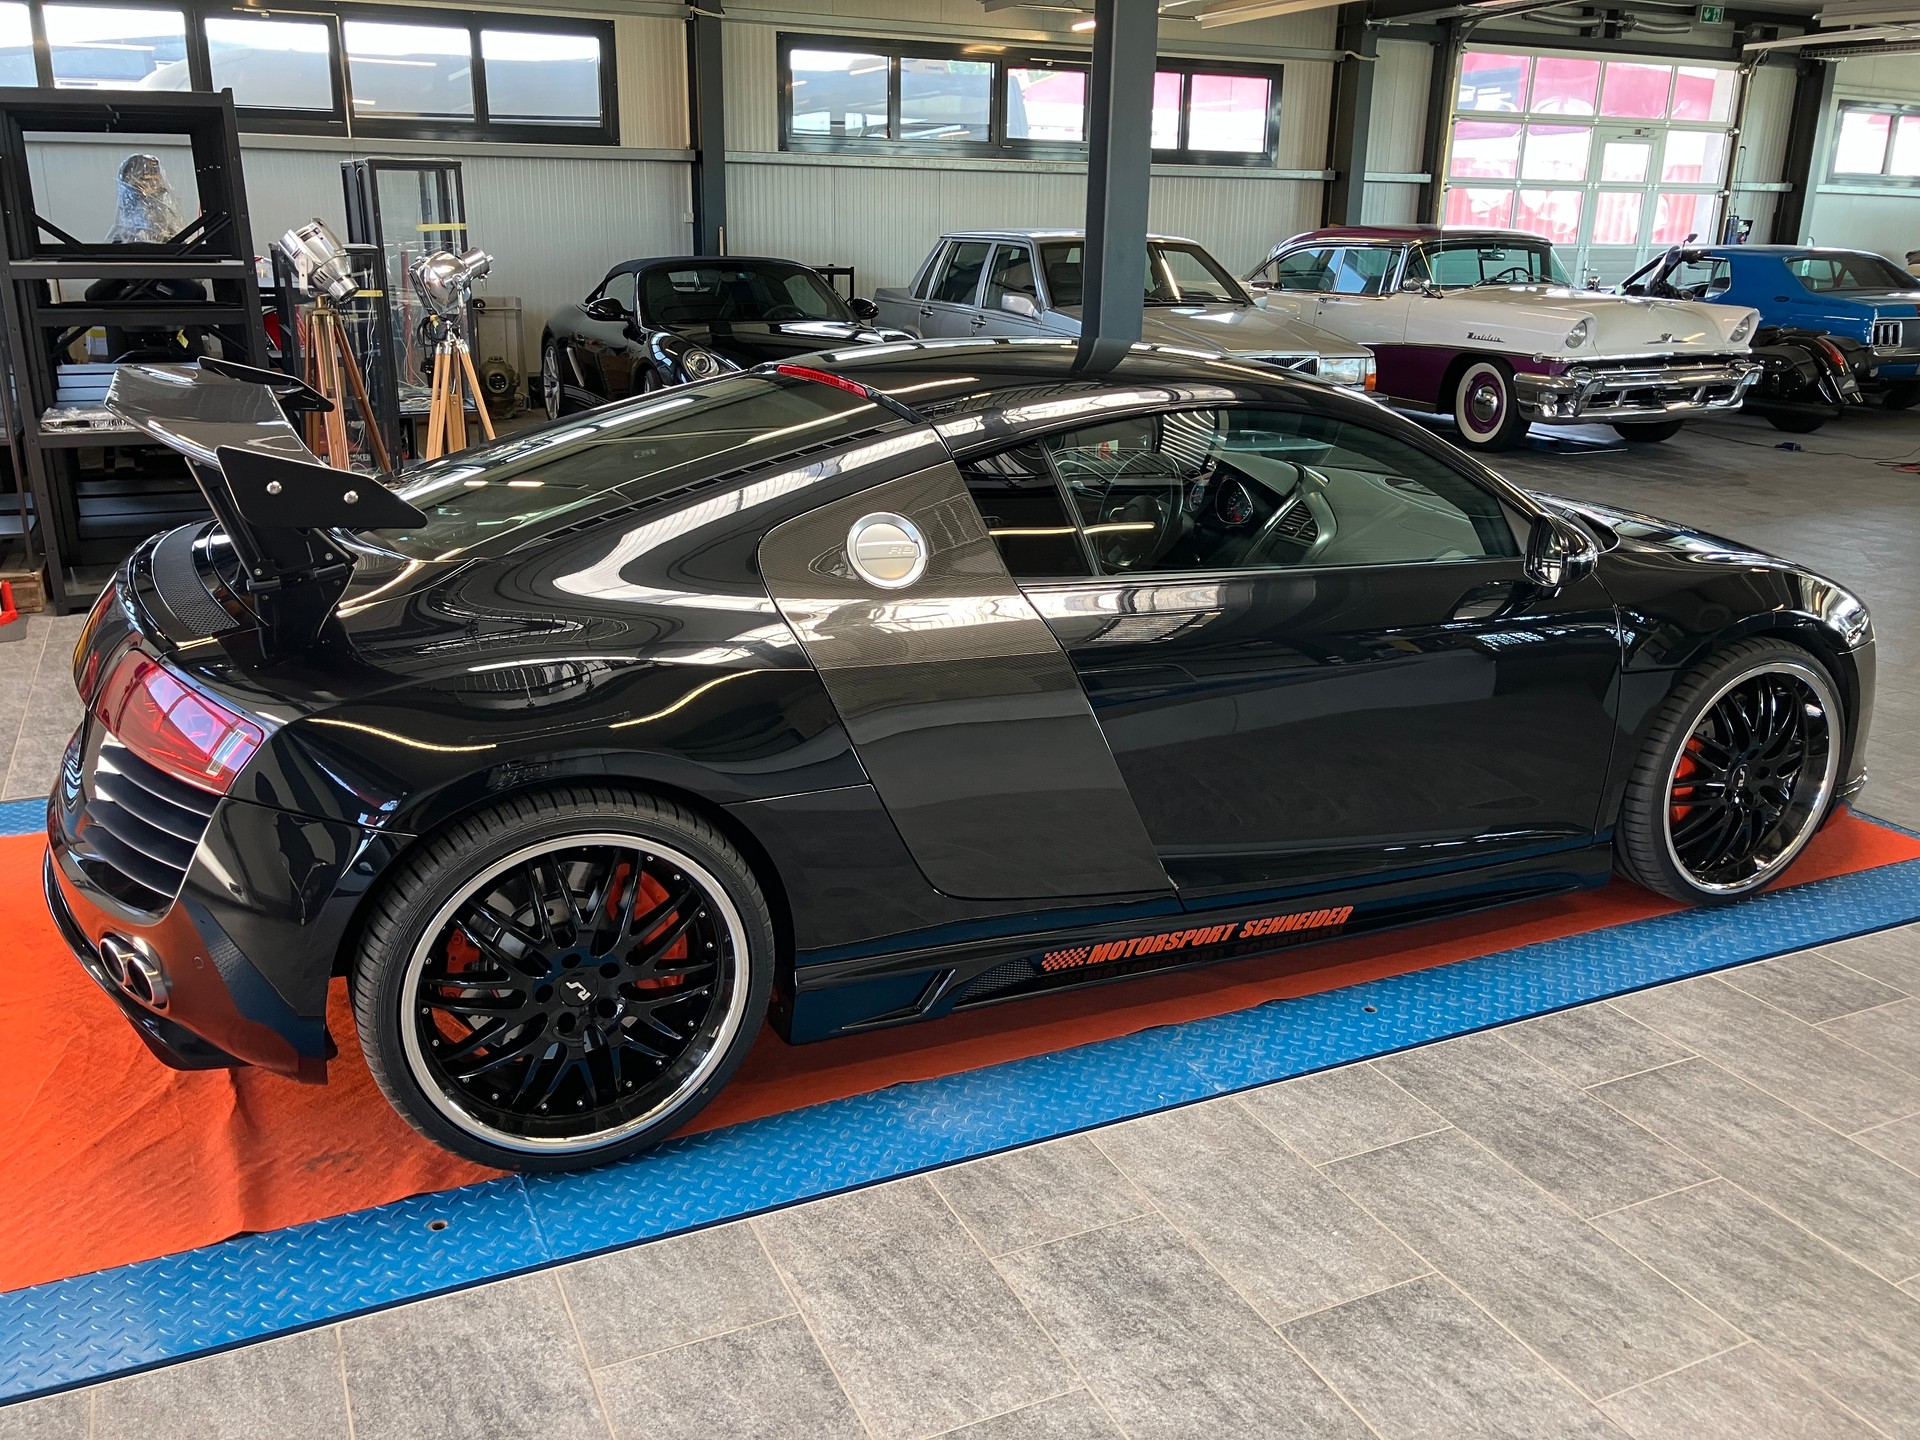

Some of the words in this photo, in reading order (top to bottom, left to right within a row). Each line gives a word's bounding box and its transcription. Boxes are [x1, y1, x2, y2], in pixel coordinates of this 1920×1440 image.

[888, 545, 914, 555] R8
[1086, 922, 1239, 964] MOTORSPORT
[1239, 905, 1354, 938] SCHNEIDER
